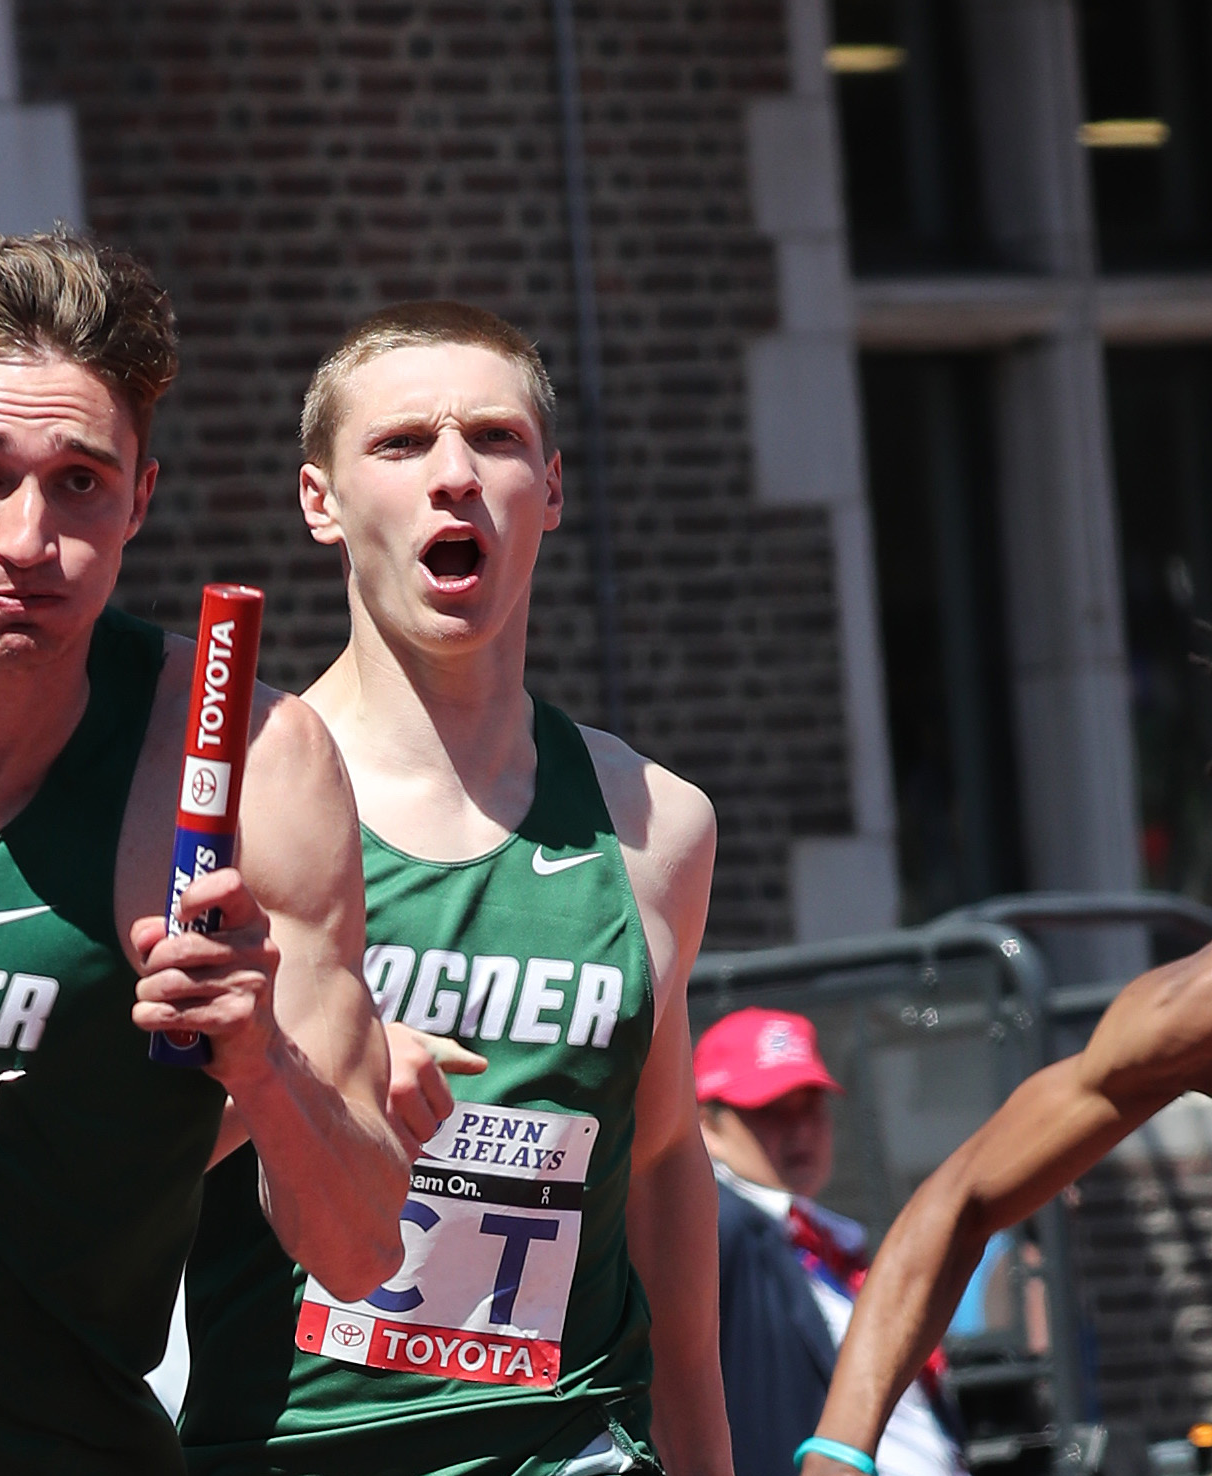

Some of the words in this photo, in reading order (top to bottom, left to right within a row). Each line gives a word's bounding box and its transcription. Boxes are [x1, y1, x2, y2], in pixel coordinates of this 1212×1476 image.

[197, 619, 236, 751] TOYOTA
[362, 943, 624, 1048] AGNER
[457, 1112, 549, 1144] PENN
[448, 1138, 567, 1171] RELAYS
[446, 1174, 483, 1198] On.
[478, 1212, 561, 1325] T
[382, 1328, 535, 1379] TOYOTA
